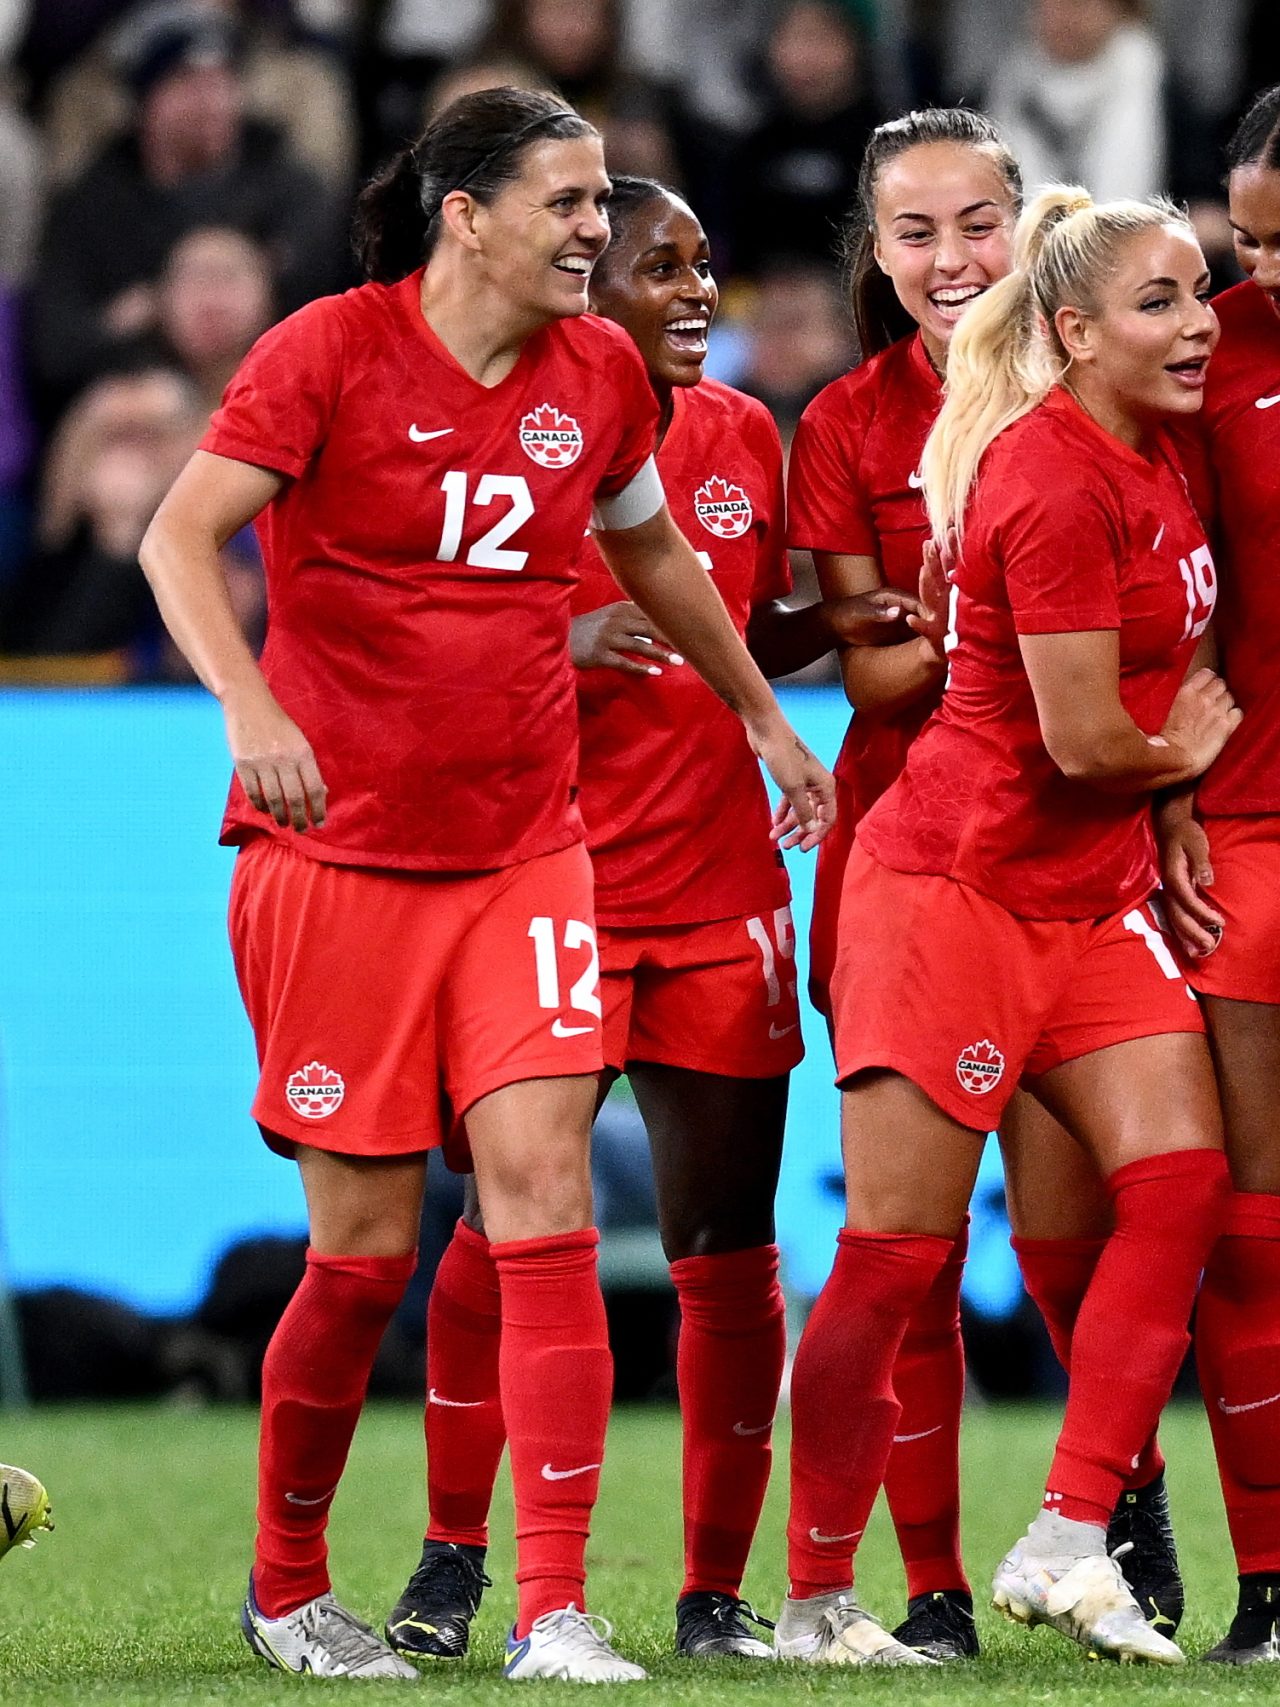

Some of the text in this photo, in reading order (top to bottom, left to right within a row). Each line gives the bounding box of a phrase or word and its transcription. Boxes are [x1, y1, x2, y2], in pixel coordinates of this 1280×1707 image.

[522, 431, 580, 443] CANADA
[698, 502, 749, 515] CANADA
[436, 470, 536, 572] 12
[1178, 543, 1217, 643] 19
[528, 917, 602, 1019] 12
[958, 1060, 1001, 1075] CANADA
[288, 1087, 342, 1096] CANADA
